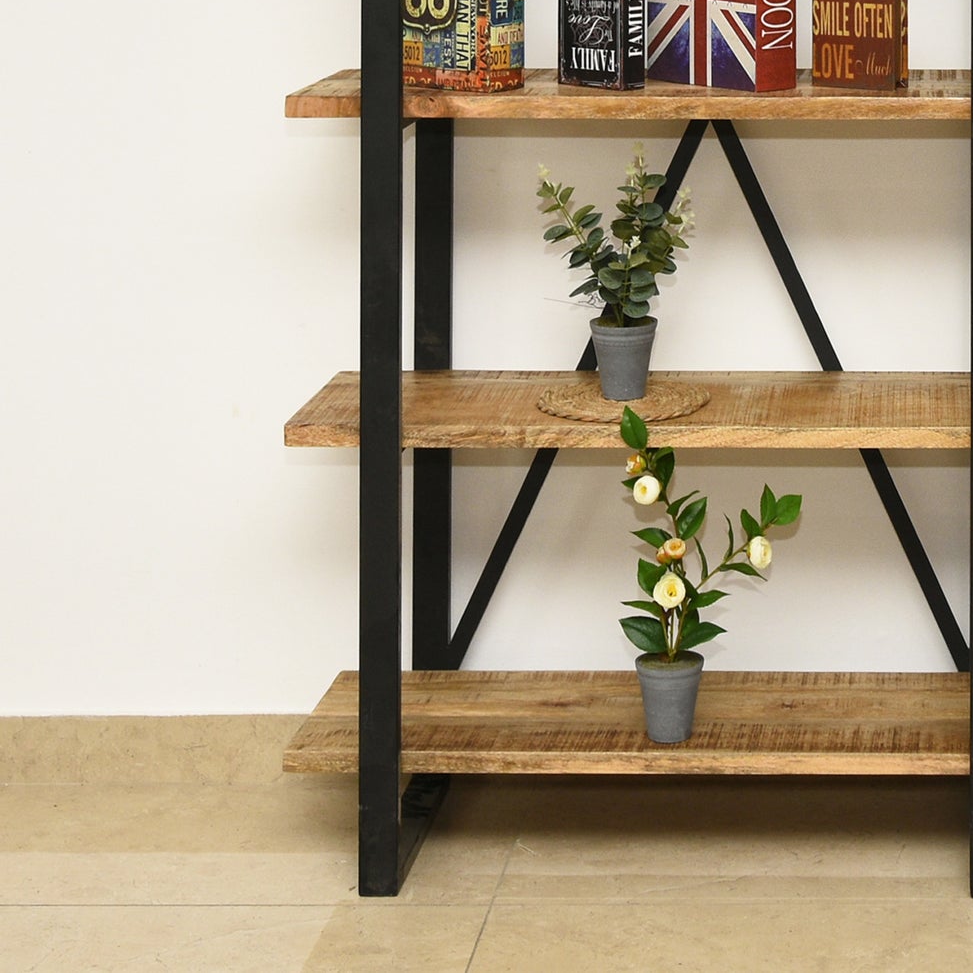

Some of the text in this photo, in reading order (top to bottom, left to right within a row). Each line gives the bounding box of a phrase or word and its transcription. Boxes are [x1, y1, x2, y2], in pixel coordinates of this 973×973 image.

[812, 0, 894, 39] SMILE OFTEN
[404, 45, 420, 61] 5012
[456, 32, 470, 70] THAT
[570, 46, 616, 72] FAMILY
[812, 42, 855, 79] LOVE
